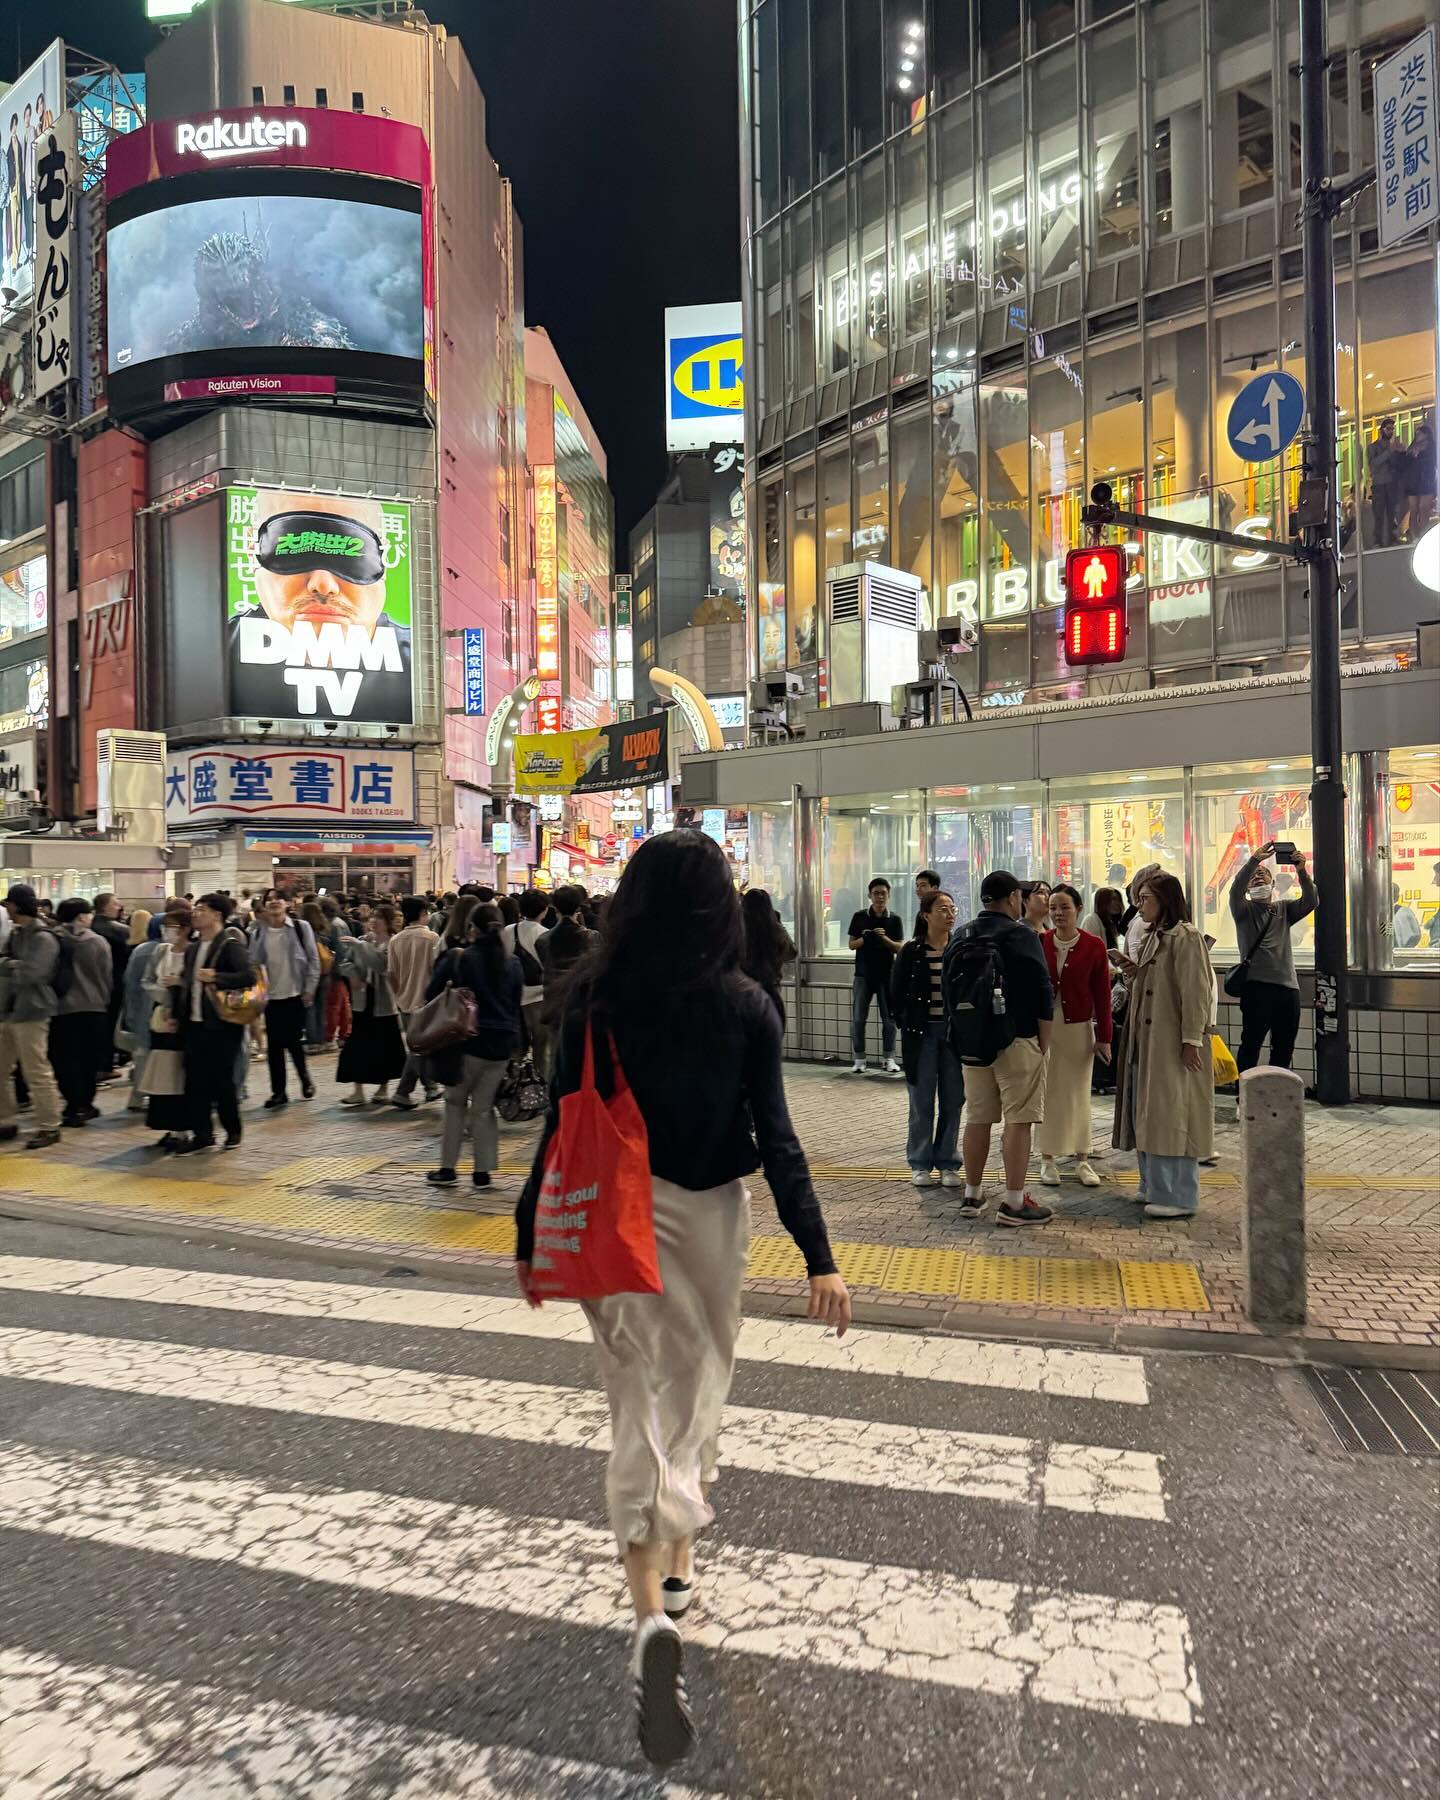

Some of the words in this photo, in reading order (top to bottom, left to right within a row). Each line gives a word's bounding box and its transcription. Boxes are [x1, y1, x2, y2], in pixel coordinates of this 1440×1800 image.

[177, 117, 307, 155] Rakuten
[1383, 97, 1398, 171] Shibuya
[1399, 53, 1431, 221] 渋谷駅前
[1385, 175, 1399, 214] Sta.
[37, 134, 70, 377] もんじゃ
[208, 380, 248, 391] Rakuten
[250, 378, 281, 388] Vision
[228, 495, 259, 614] 脱出せよ
[277, 531, 366, 557] 大脱出2
[290, 546, 314, 555] GREAT
[380, 513, 407, 569] 再び
[239, 616, 404, 673] DMM
[283, 670, 364, 717] TV
[467, 633, 482, 713] 大盛堂商事ビル
[166, 760, 393, 808] 大盛堂書店
[374, 808, 404, 816] TAISEIDO
[1104, 809, 1113, 872] 出会ってしま
[565, 1182, 598, 1206] soul
